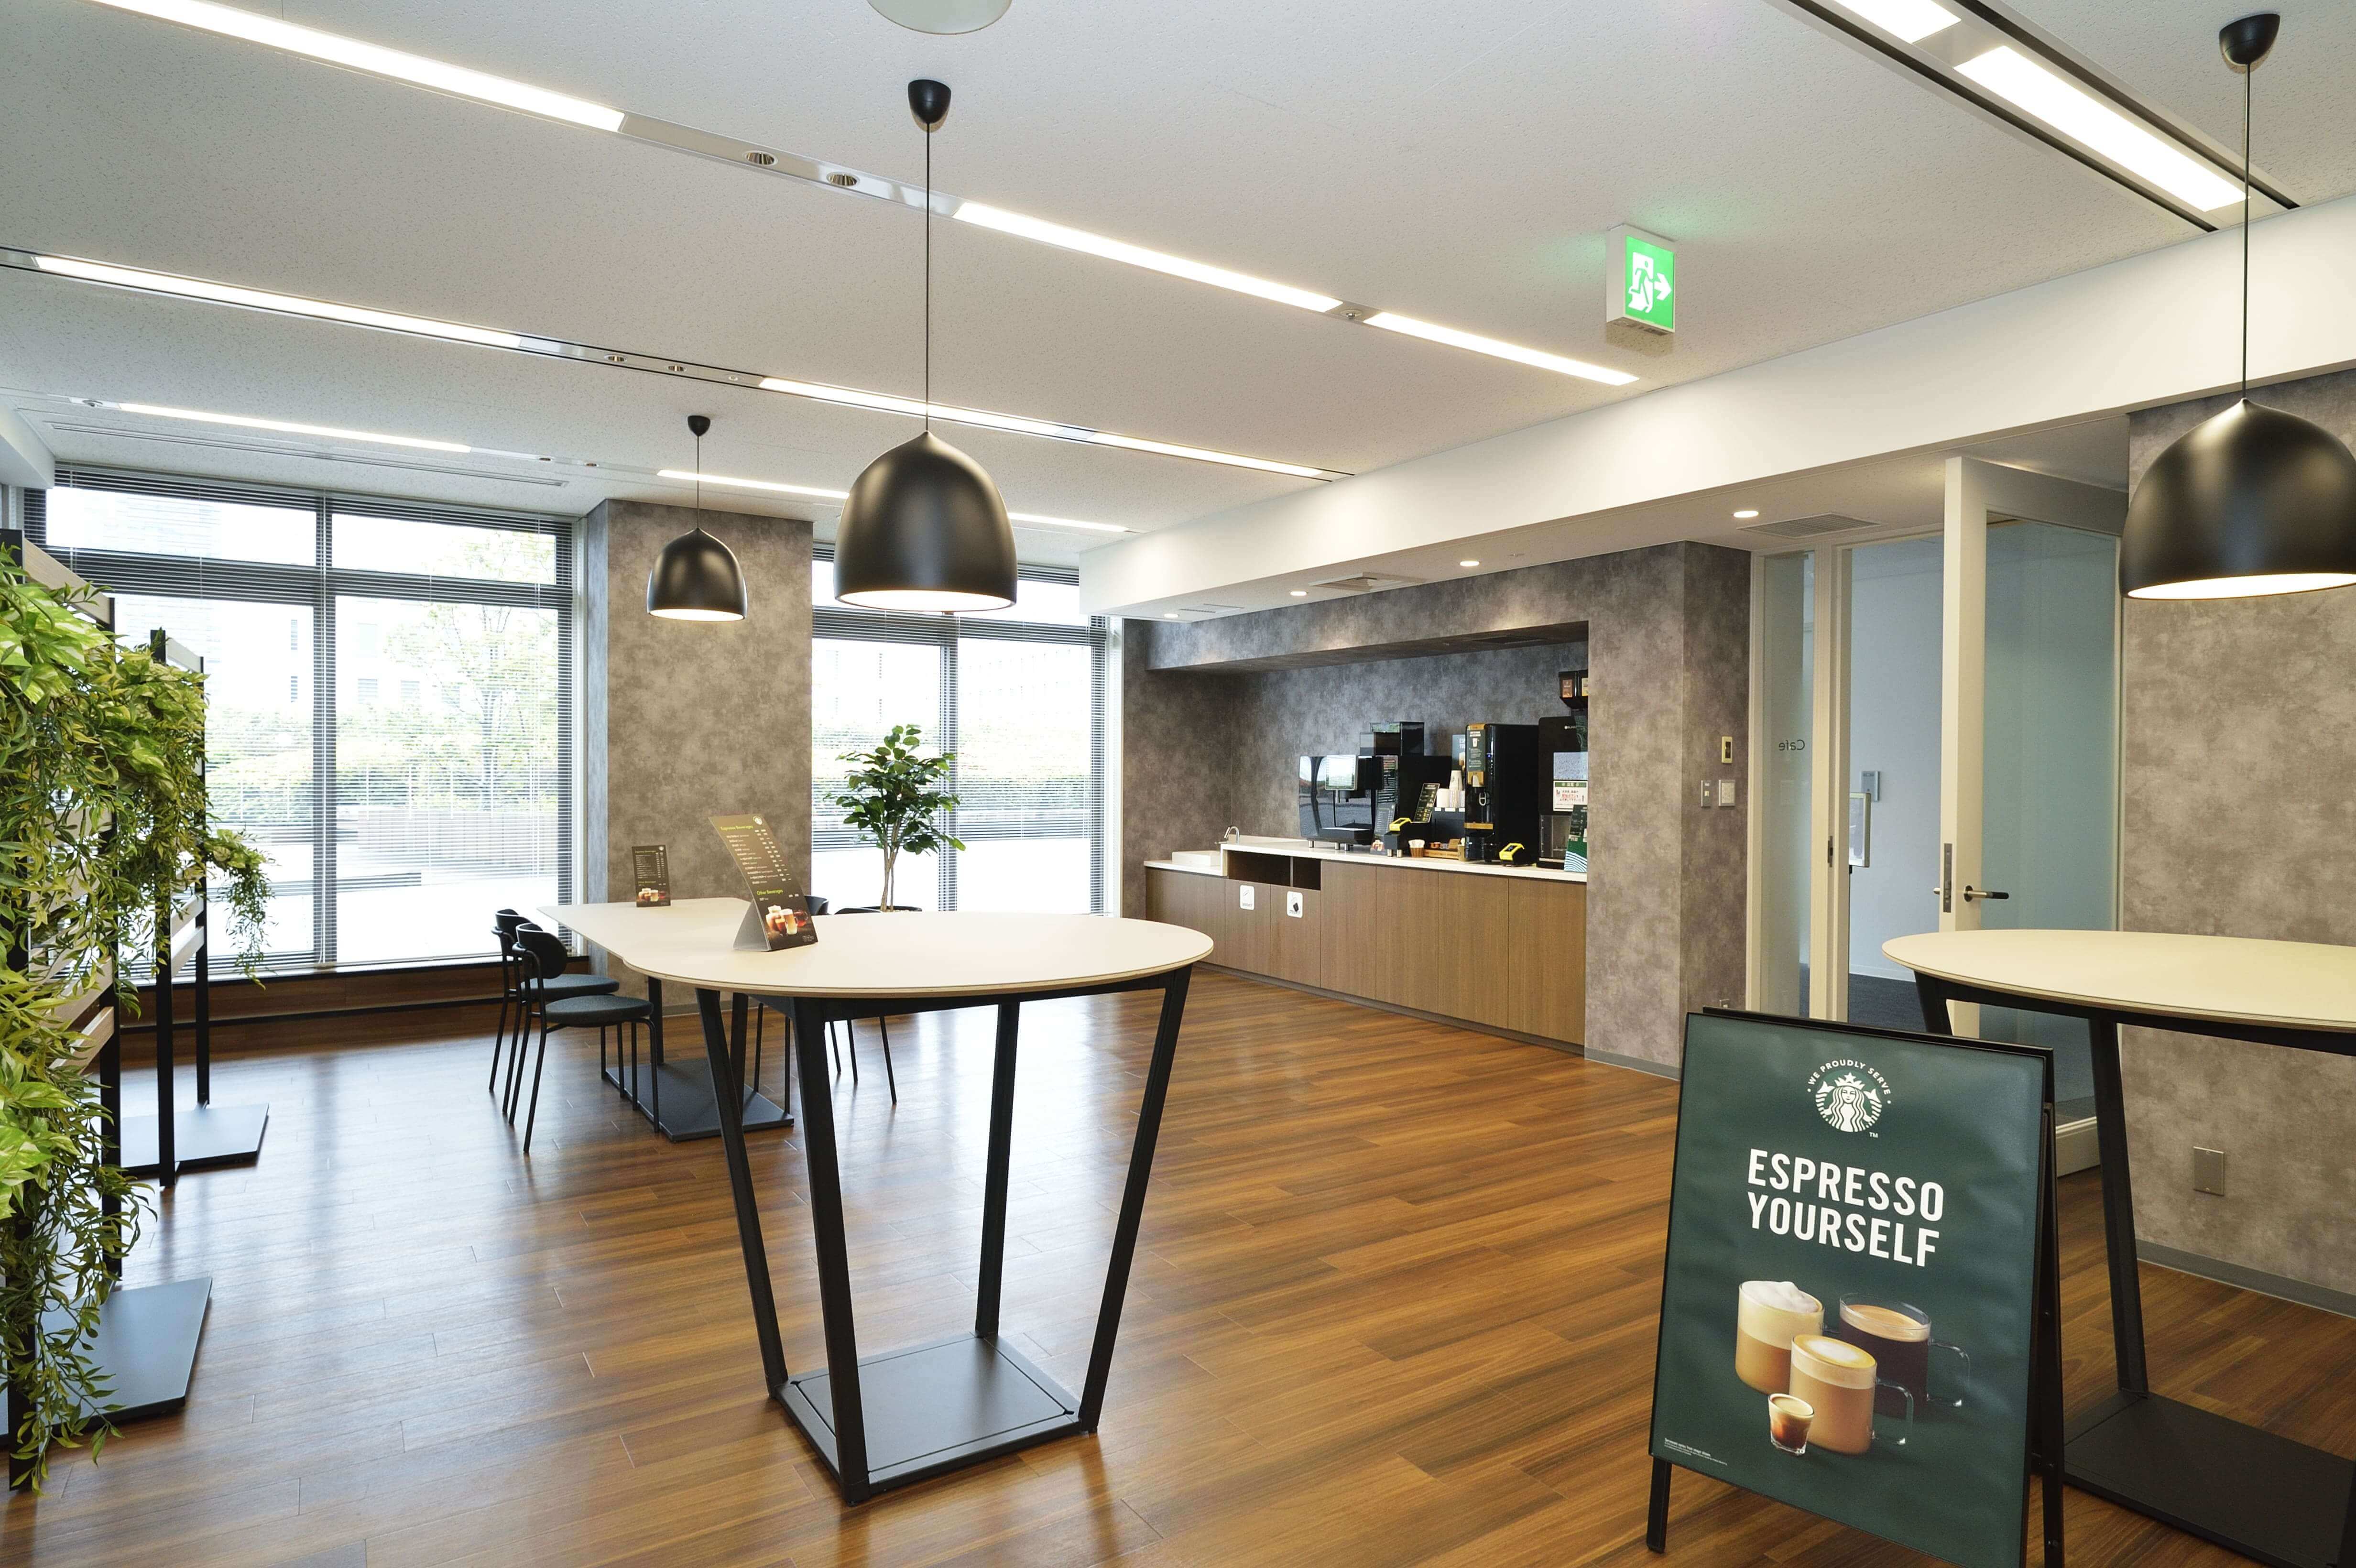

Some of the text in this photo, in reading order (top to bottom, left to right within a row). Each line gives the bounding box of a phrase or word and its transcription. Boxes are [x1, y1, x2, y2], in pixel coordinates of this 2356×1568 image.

[1808, 1059, 1891, 1095] WE PROUDLY SERVE
[1748, 1148, 1944, 1221] ESPRESSO
[1747, 1191, 1940, 1267] YOURSELF
